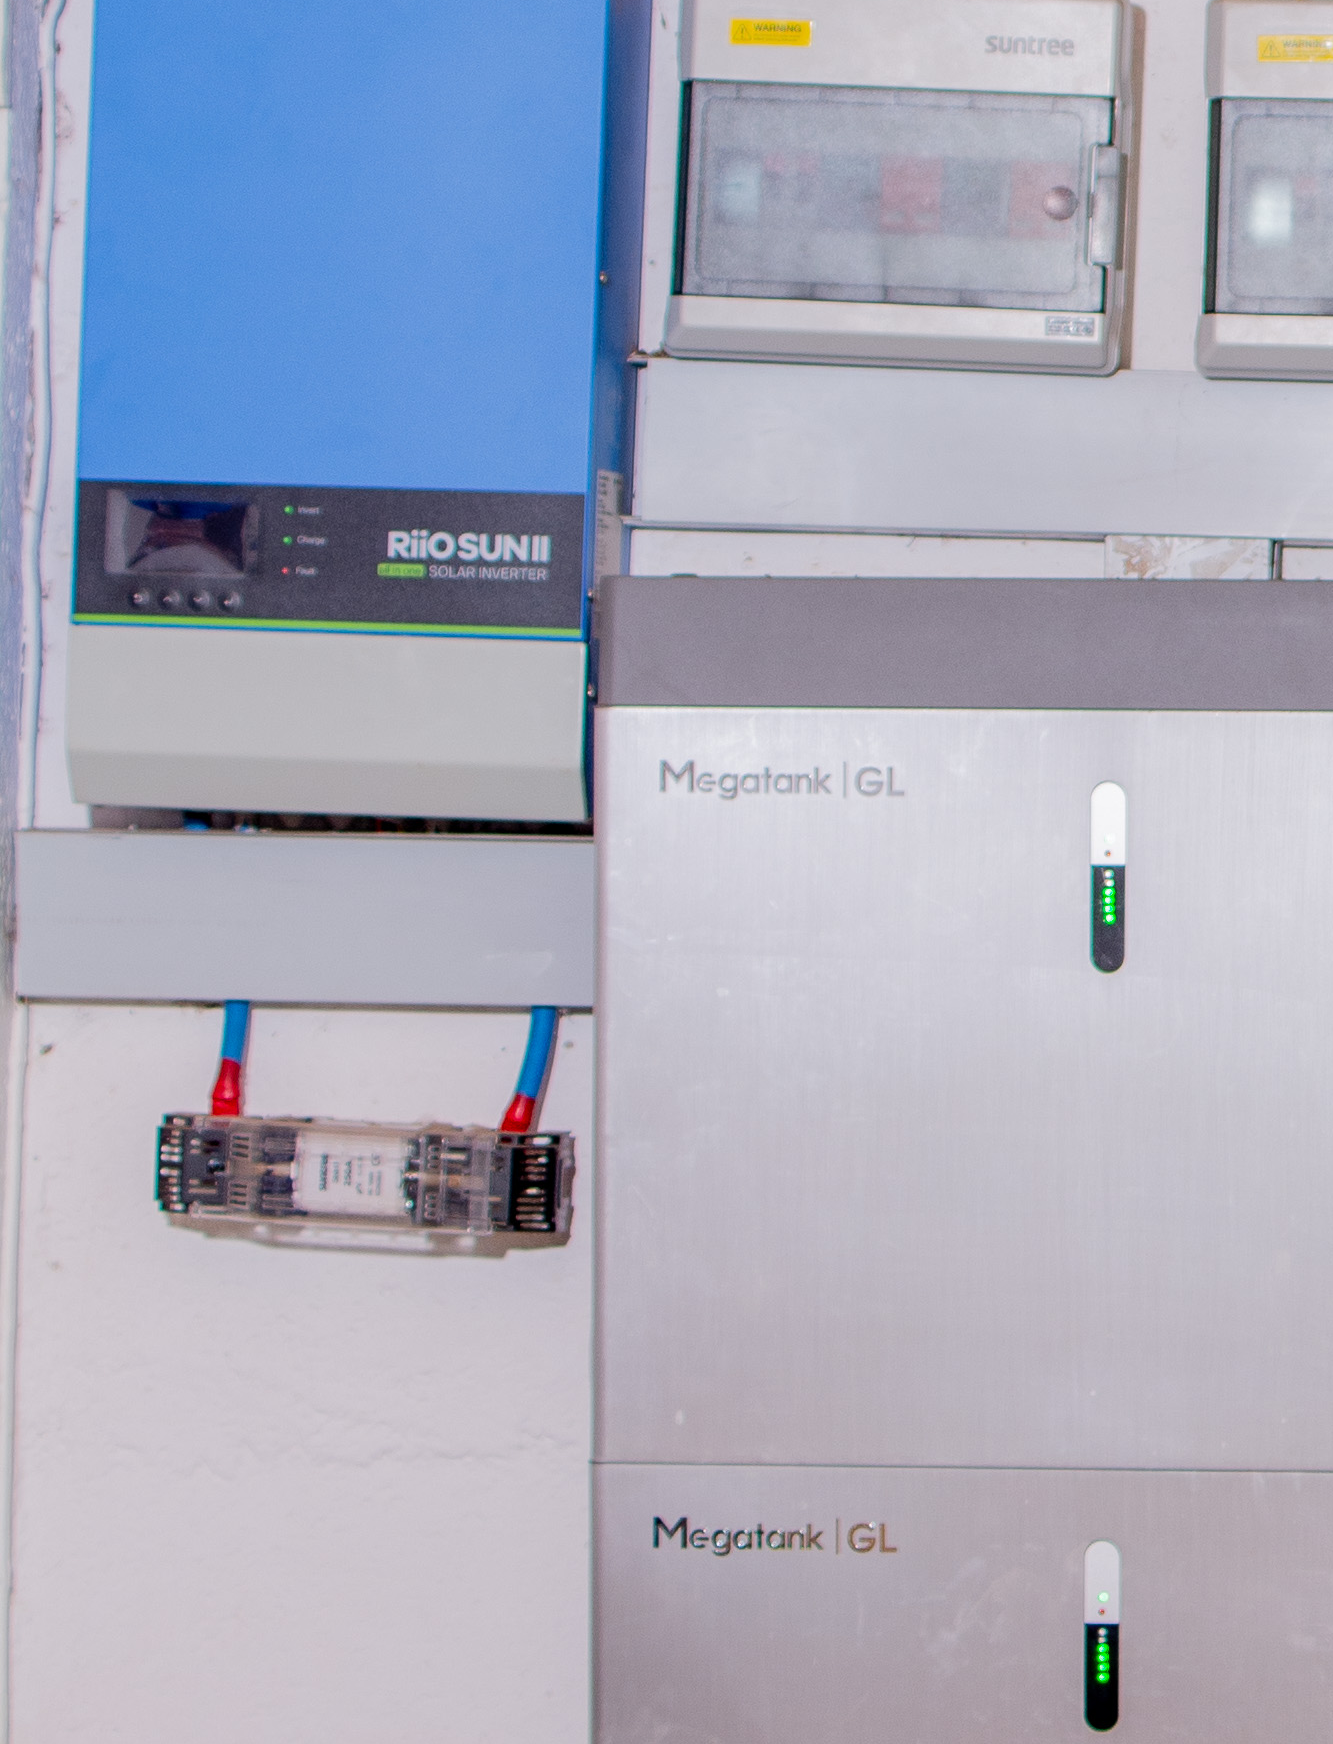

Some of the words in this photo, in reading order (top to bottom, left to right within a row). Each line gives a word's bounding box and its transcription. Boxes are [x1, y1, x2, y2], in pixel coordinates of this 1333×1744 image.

[753, 23, 802, 33] WARNING
[984, 34, 1075, 57] suntree
[428, 565, 476, 578] SOLAR
[479, 567, 547, 581] INVERTER
[658, 758, 832, 800] Megatank
[855, 765, 905, 798] GL
[652, 1516, 823, 1557] Megatank
[847, 1522, 898, 1554] GL
